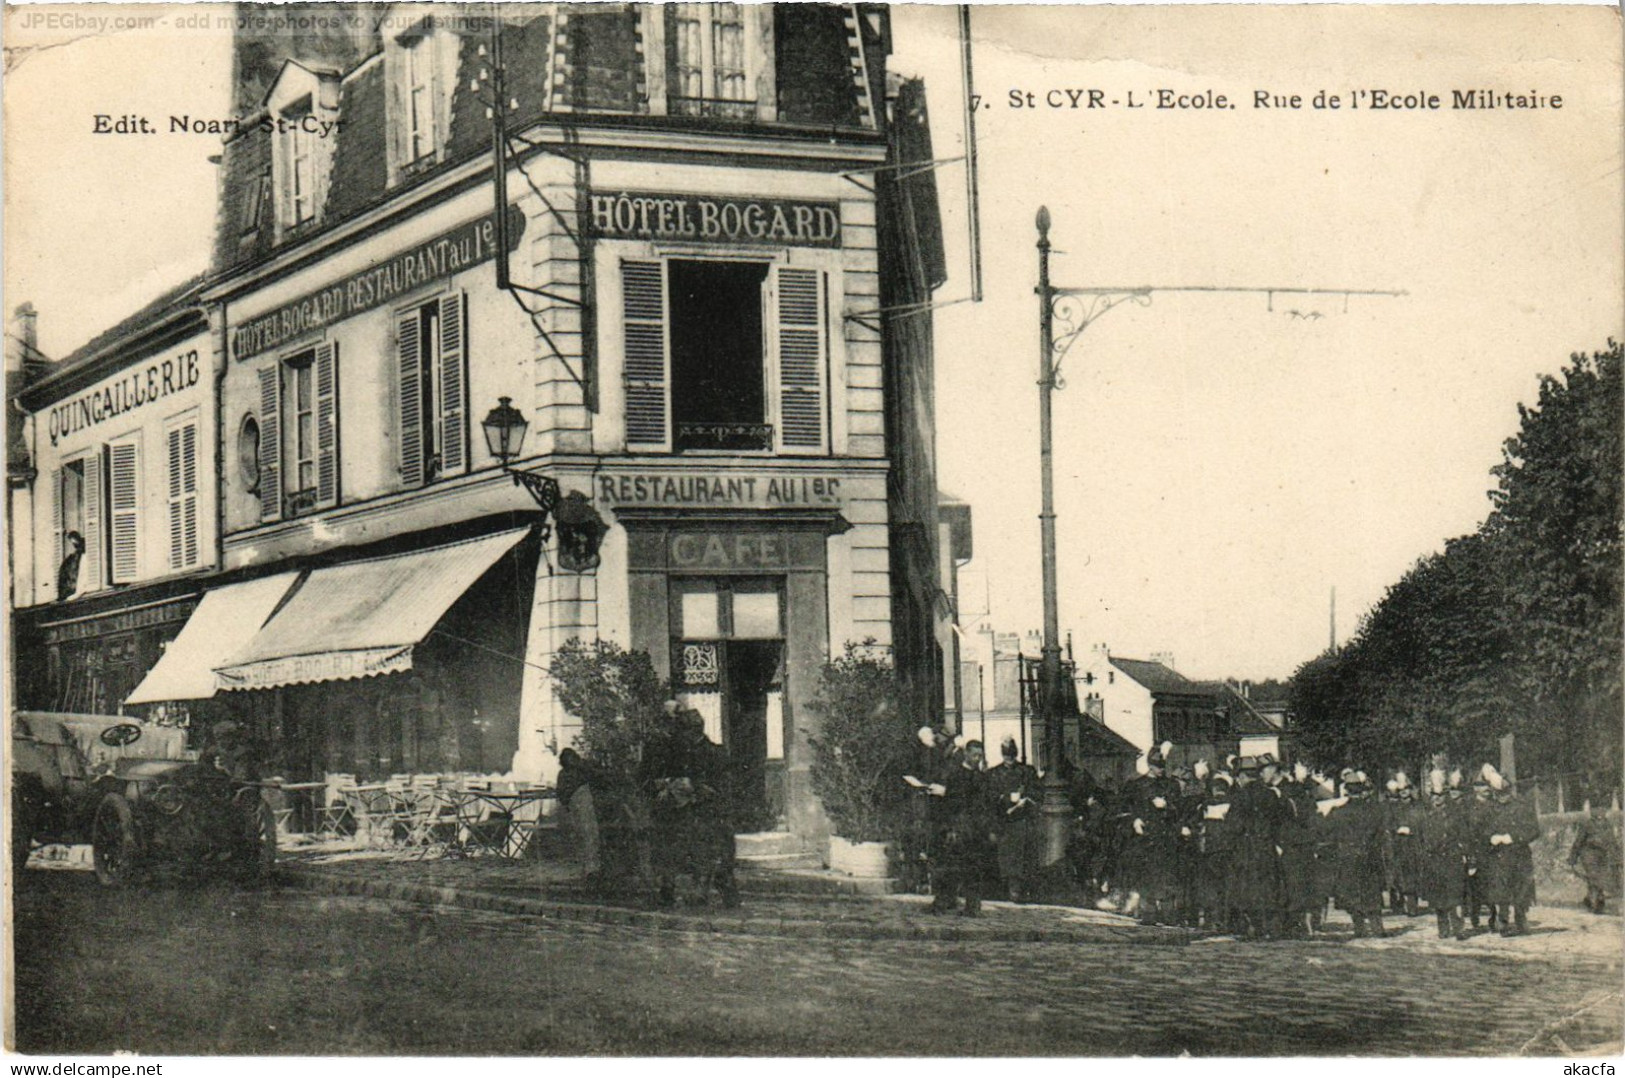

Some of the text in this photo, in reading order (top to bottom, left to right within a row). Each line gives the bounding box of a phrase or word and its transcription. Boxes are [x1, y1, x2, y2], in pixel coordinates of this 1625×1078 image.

[591, 192, 839, 242] HÔTEL BOGARD
[281, 287, 343, 339] BOGARD
[346, 239, 449, 311] RESTAURANT
[600, 474, 756, 503] RESTAURANT
